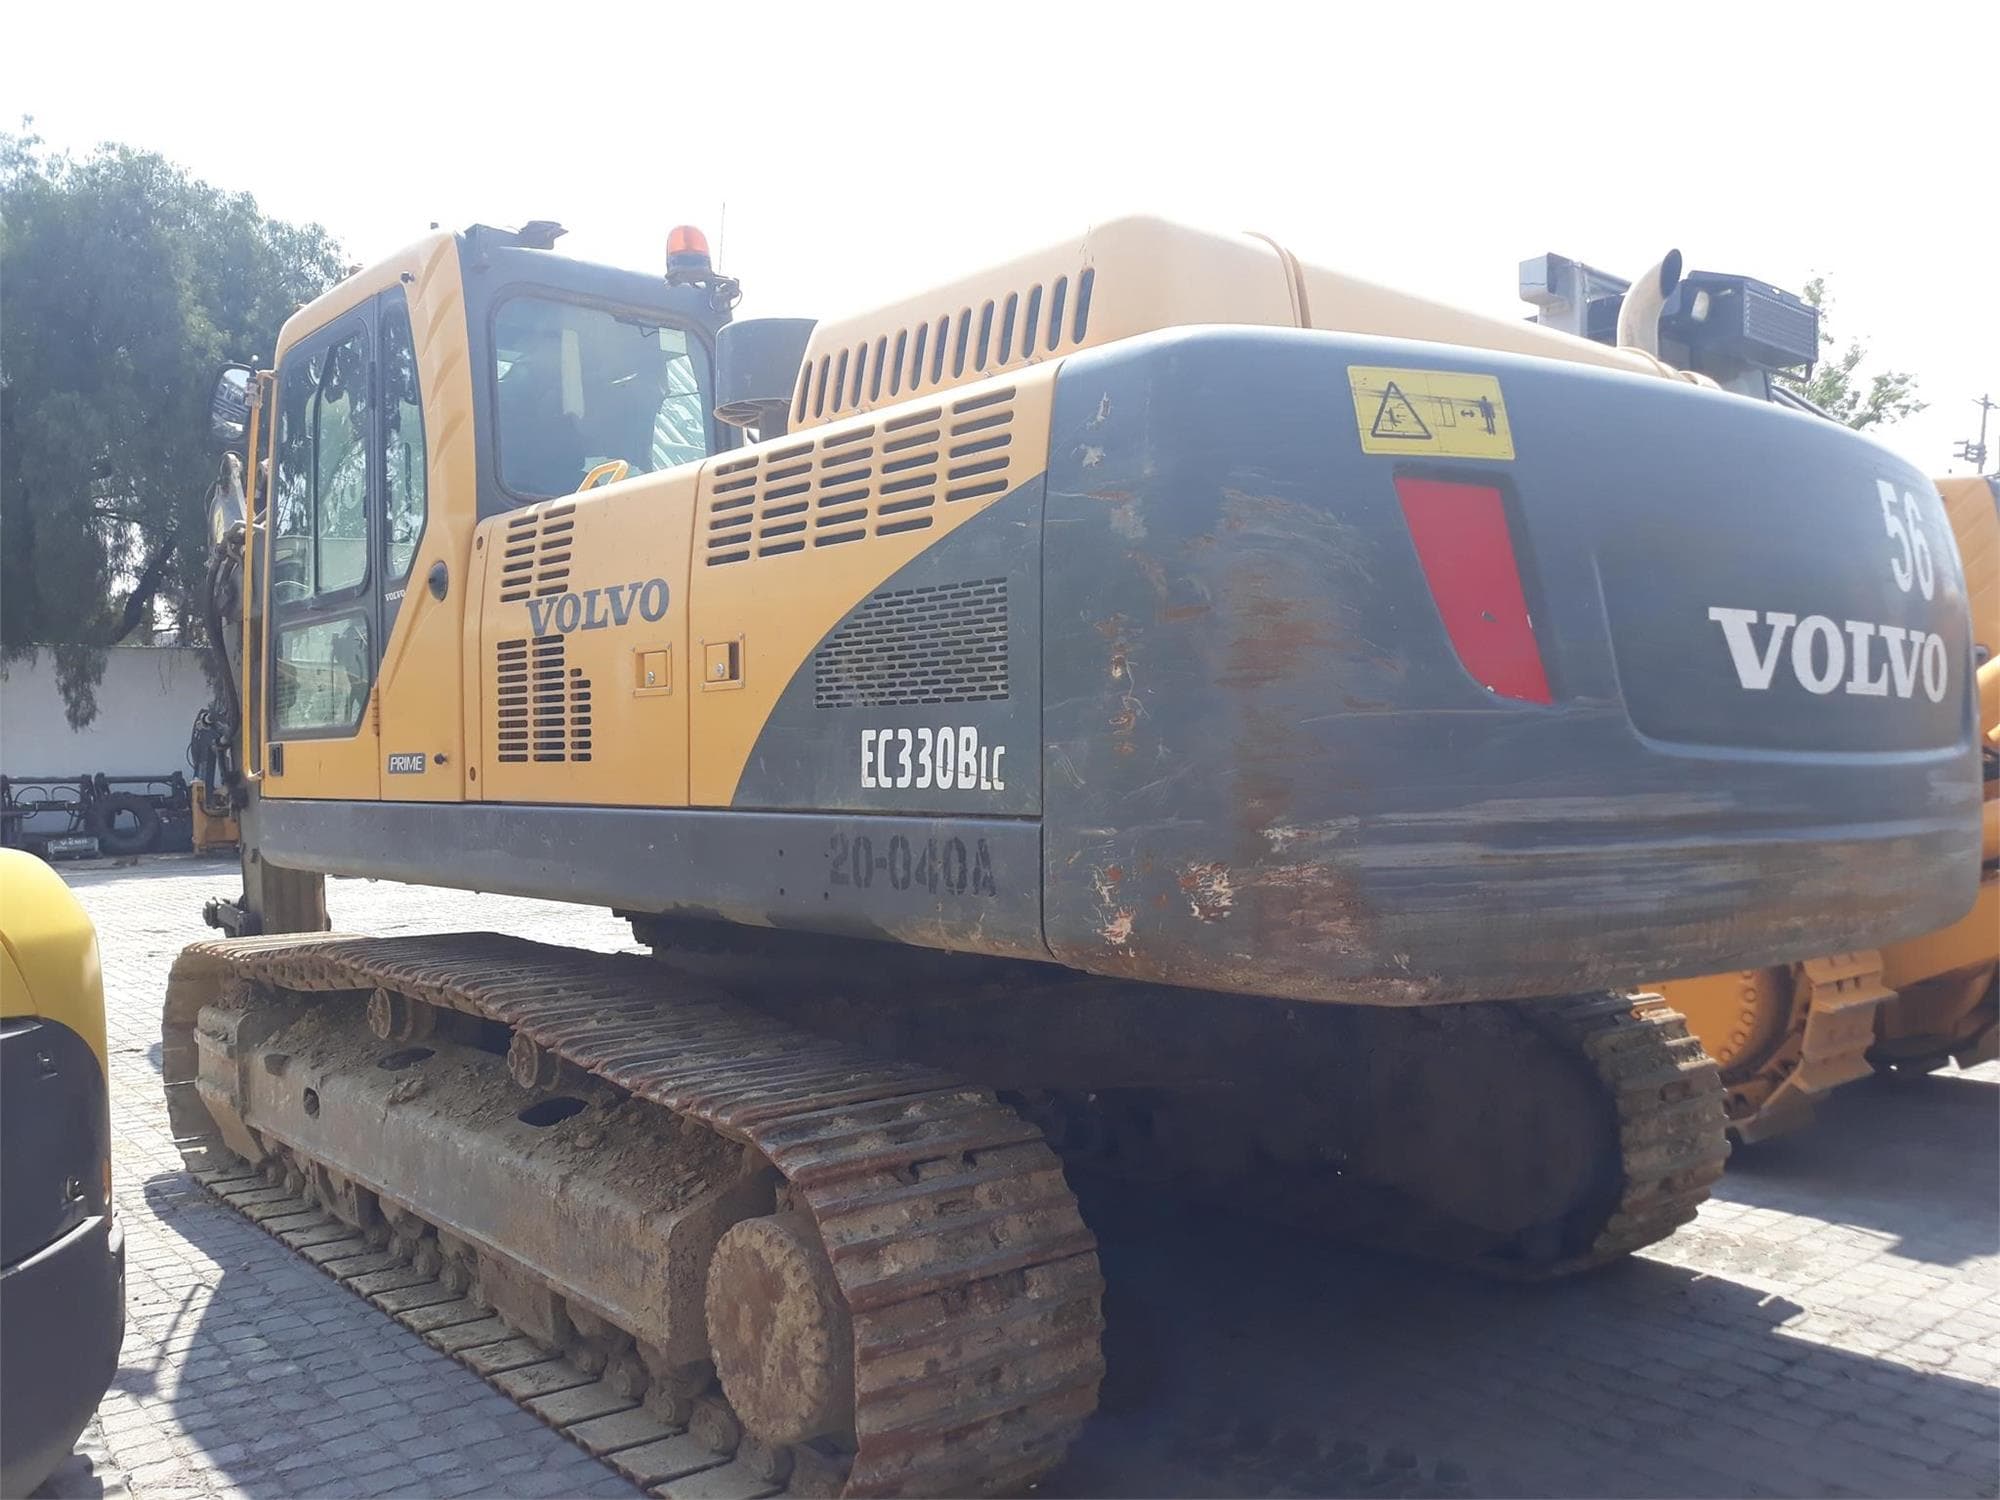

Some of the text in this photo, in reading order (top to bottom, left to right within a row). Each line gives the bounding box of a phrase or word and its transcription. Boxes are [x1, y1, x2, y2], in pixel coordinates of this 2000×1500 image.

[1877, 480, 1934, 600] 56
[526, 579, 669, 636] VOLVO
[1708, 607, 1947, 702] VOLVO
[390, 757, 423, 771] PRIME
[830, 835, 996, 896] 20-040A
